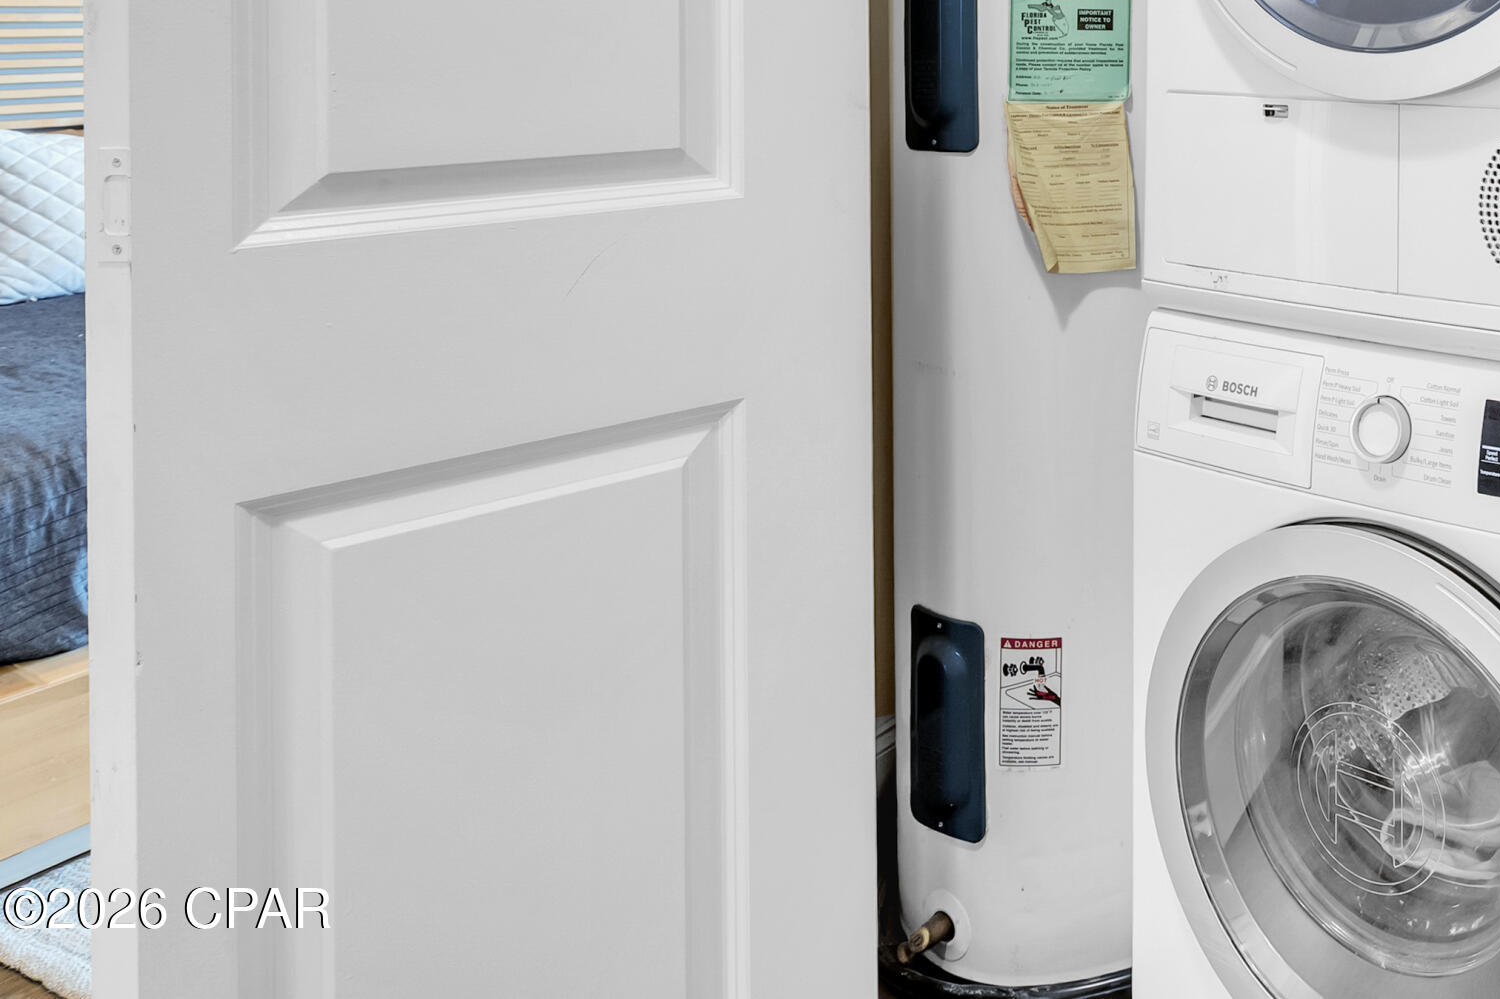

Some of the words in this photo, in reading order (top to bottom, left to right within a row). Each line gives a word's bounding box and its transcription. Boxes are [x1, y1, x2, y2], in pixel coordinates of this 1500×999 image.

[1021, 12, 1047, 21] FLORIDA
[1024, 19, 1041, 27] PEST
[1027, 26, 1056, 34] CONTROL
[1222, 380, 1258, 397] BOSCH
[1443, 385, 1461, 393] Normal
[1436, 398, 1449, 406] Light
[1449, 400, 1459, 408] Soil
[1319, 409, 1338, 418] Delicates
[1440, 414, 1456, 423] Towels
[1409, 455, 1438, 467] Bulky/Large
[1438, 461, 1452, 469] Items
[1373, 474, 1386, 482] Drain
[1423, 473, 1436, 482] Drum
[1014, 640, 1058, 649] DANGER
